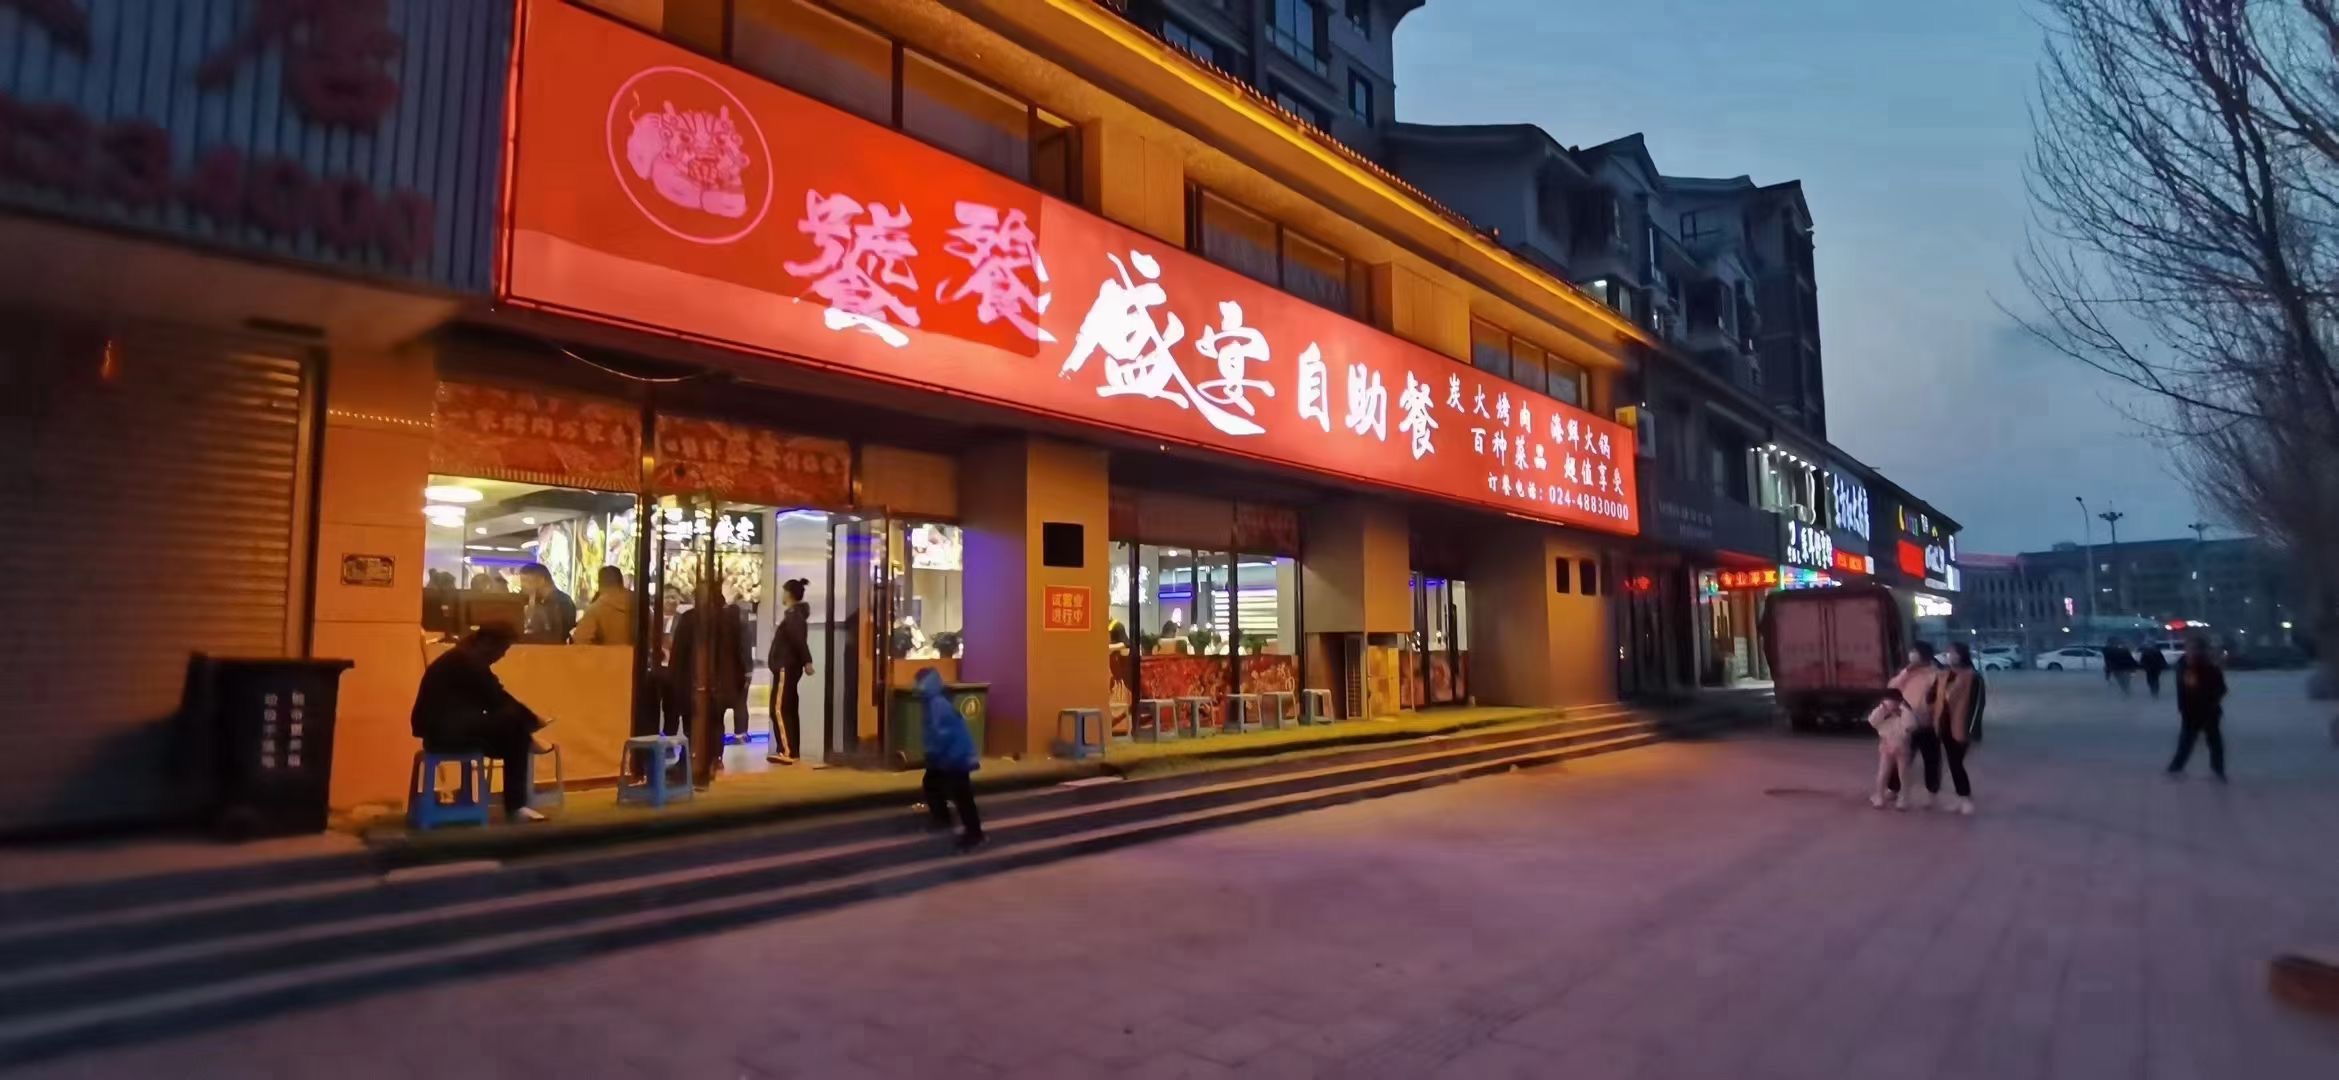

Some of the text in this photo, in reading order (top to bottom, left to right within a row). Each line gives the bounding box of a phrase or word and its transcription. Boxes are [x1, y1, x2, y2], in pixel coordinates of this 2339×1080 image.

[1298, 340, 1440, 461] 自助餐
[1446, 372, 1611, 460] 炭火烤肉 海鲜火锅
[1470, 427, 1625, 497] 百种菜品 超值享受
